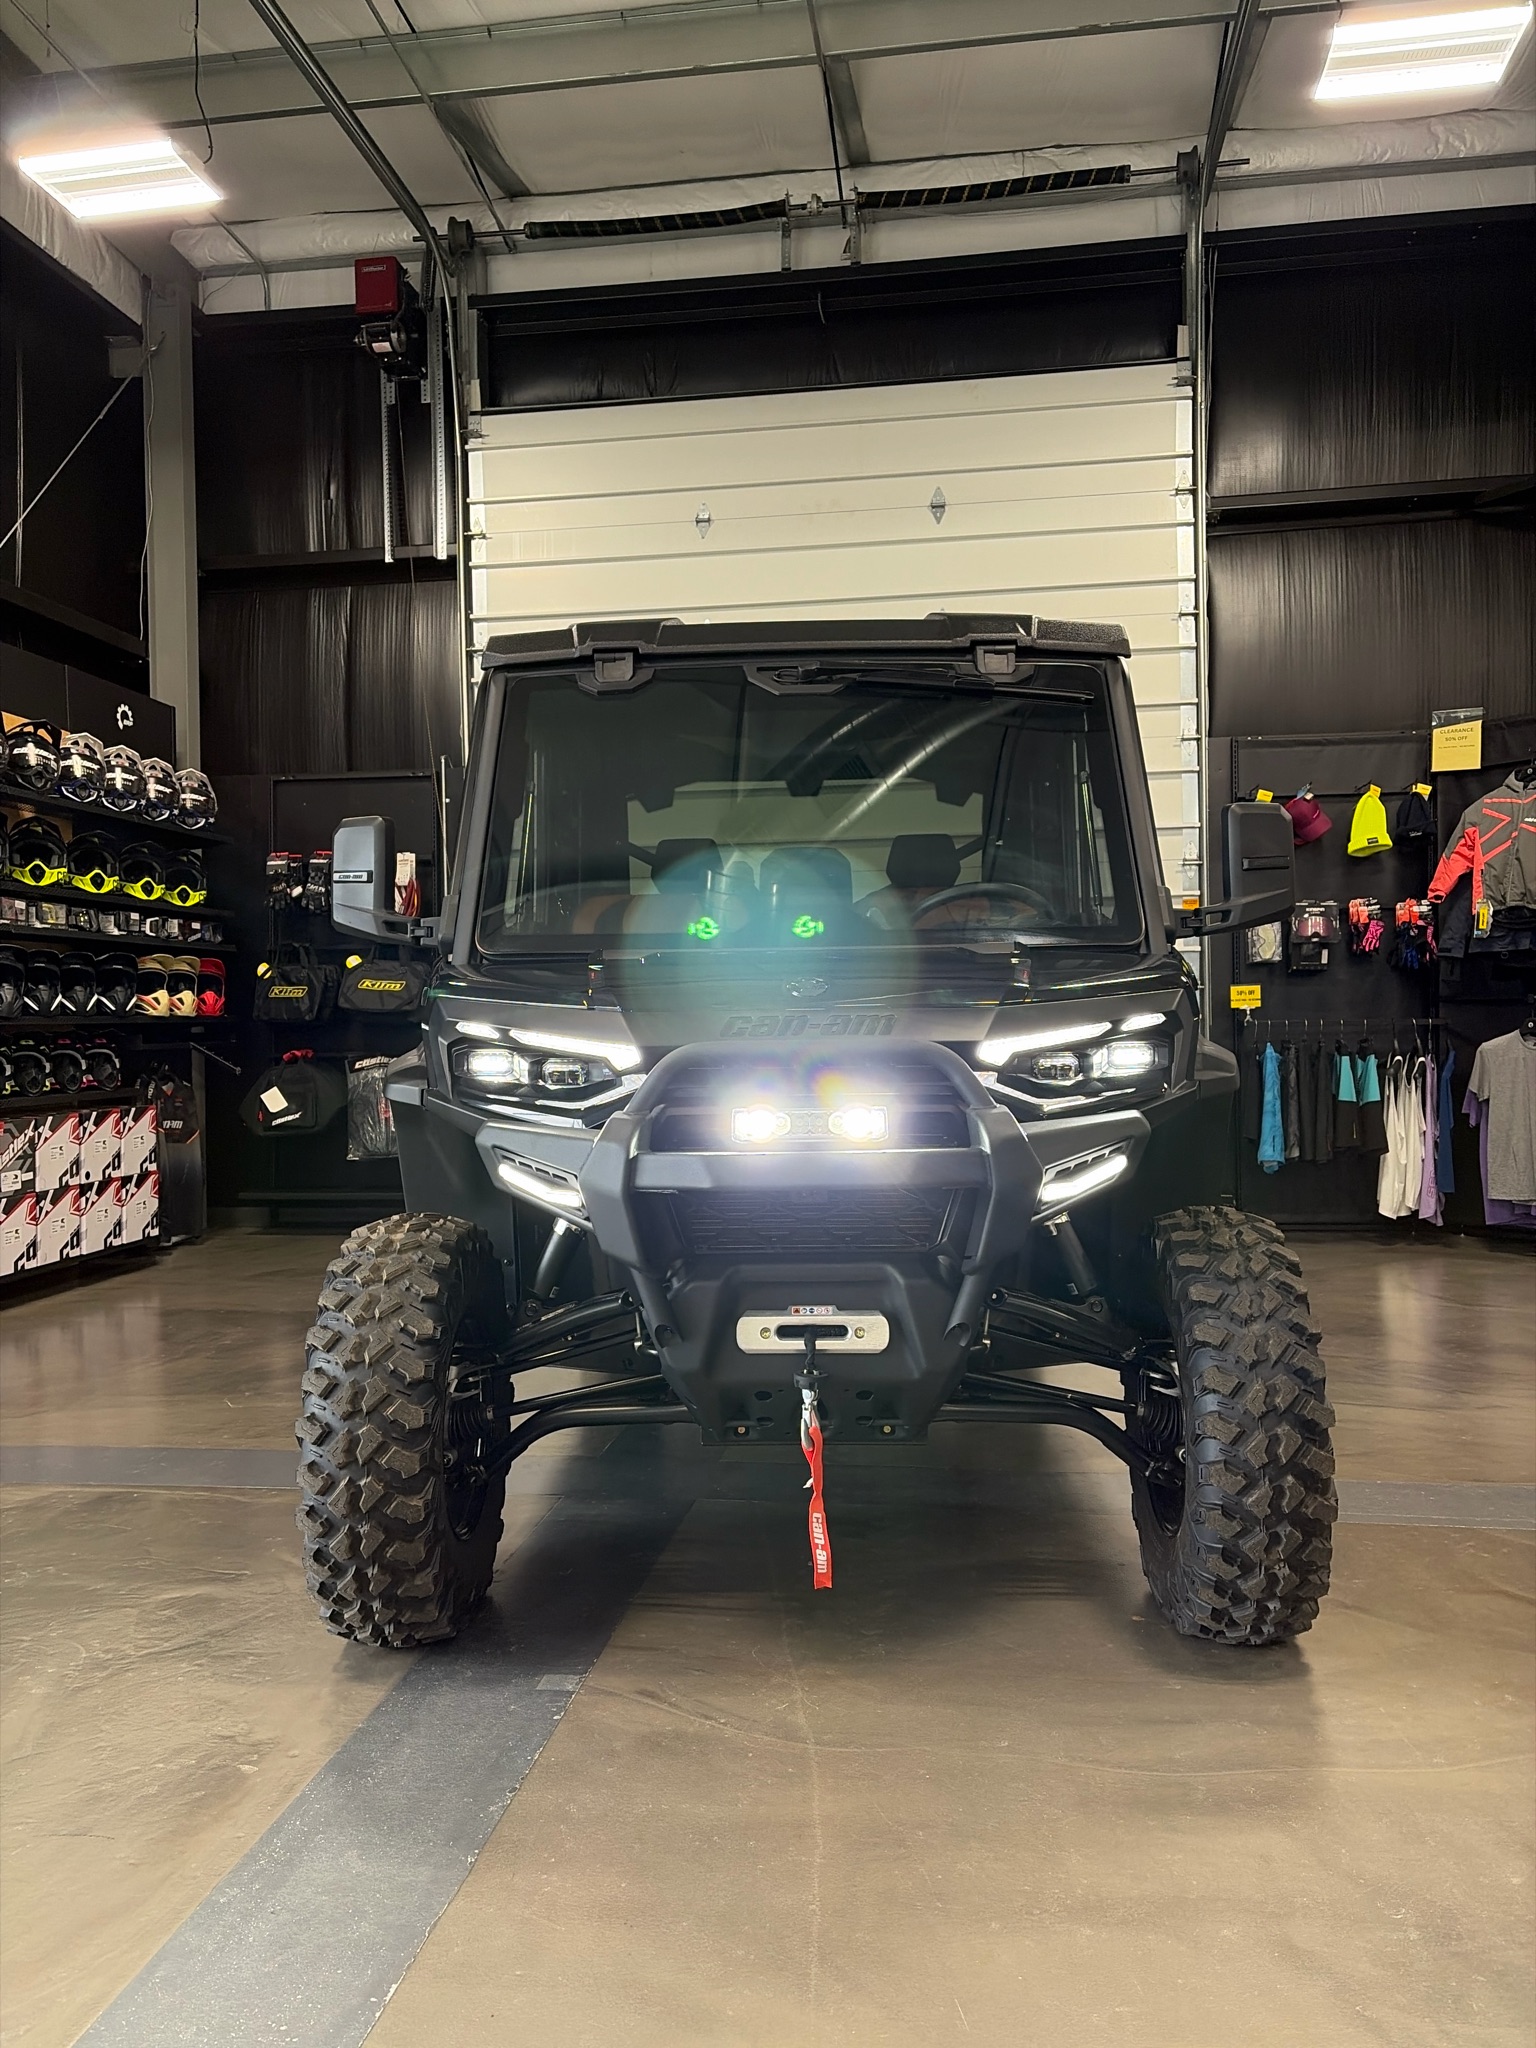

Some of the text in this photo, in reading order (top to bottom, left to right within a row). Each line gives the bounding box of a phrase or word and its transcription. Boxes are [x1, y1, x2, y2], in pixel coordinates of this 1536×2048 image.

[1439, 727, 1474, 735] CLEARANCE
[361, 980, 402, 991] Klim
[271, 987, 305, 997] Klim
[719, 1014, 898, 1038] can-am
[812, 1512, 828, 1574] can-am
